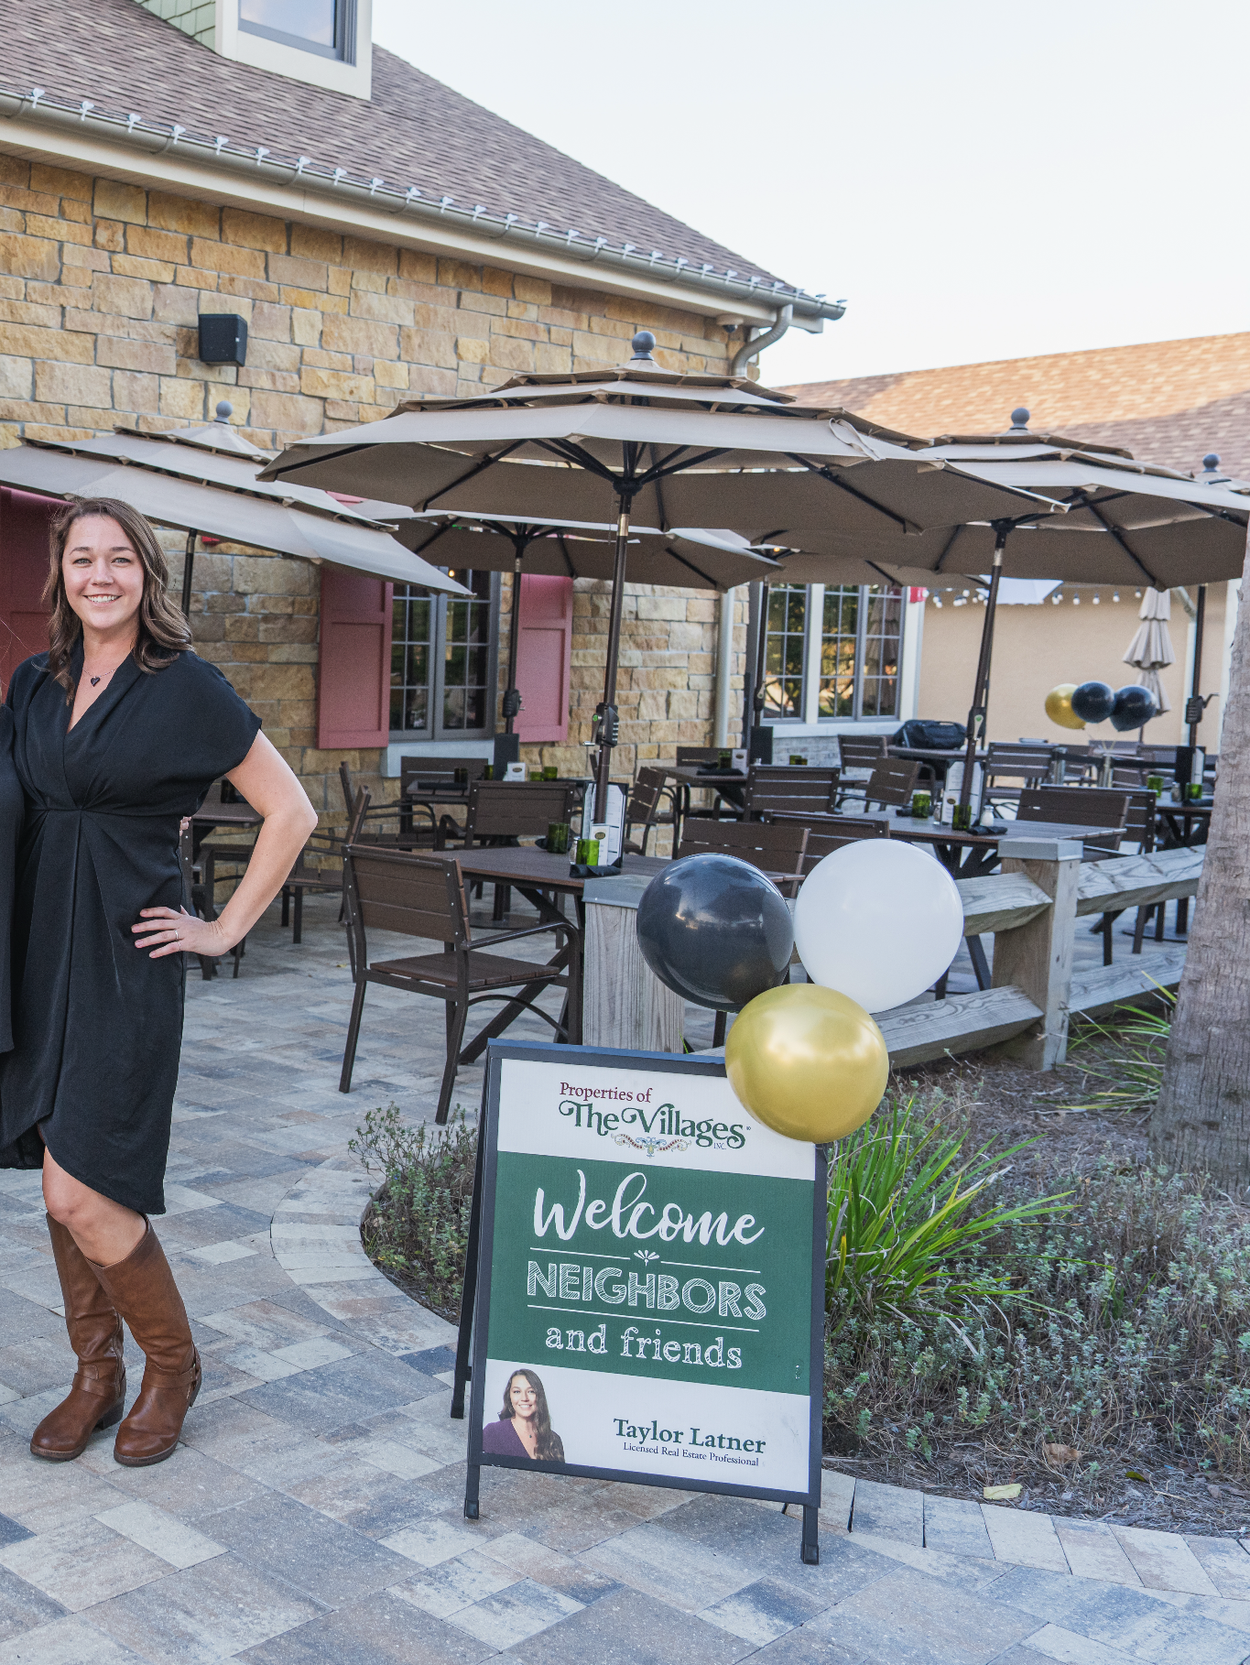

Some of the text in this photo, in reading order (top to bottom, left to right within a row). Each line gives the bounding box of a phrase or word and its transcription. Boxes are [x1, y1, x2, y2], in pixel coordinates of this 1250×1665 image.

[560, 1082, 653, 1103] Properties of
[558, 1100, 747, 1150] The Villages
[533, 1169, 765, 1246] Welcome
[526, 1260, 767, 1321] NEIGHBORS
[545, 1323, 742, 1369] and friends
[613, 1418, 766, 1454] Taylor Latner
[623, 1442, 759, 1467] Licensed Real Estate Professional
